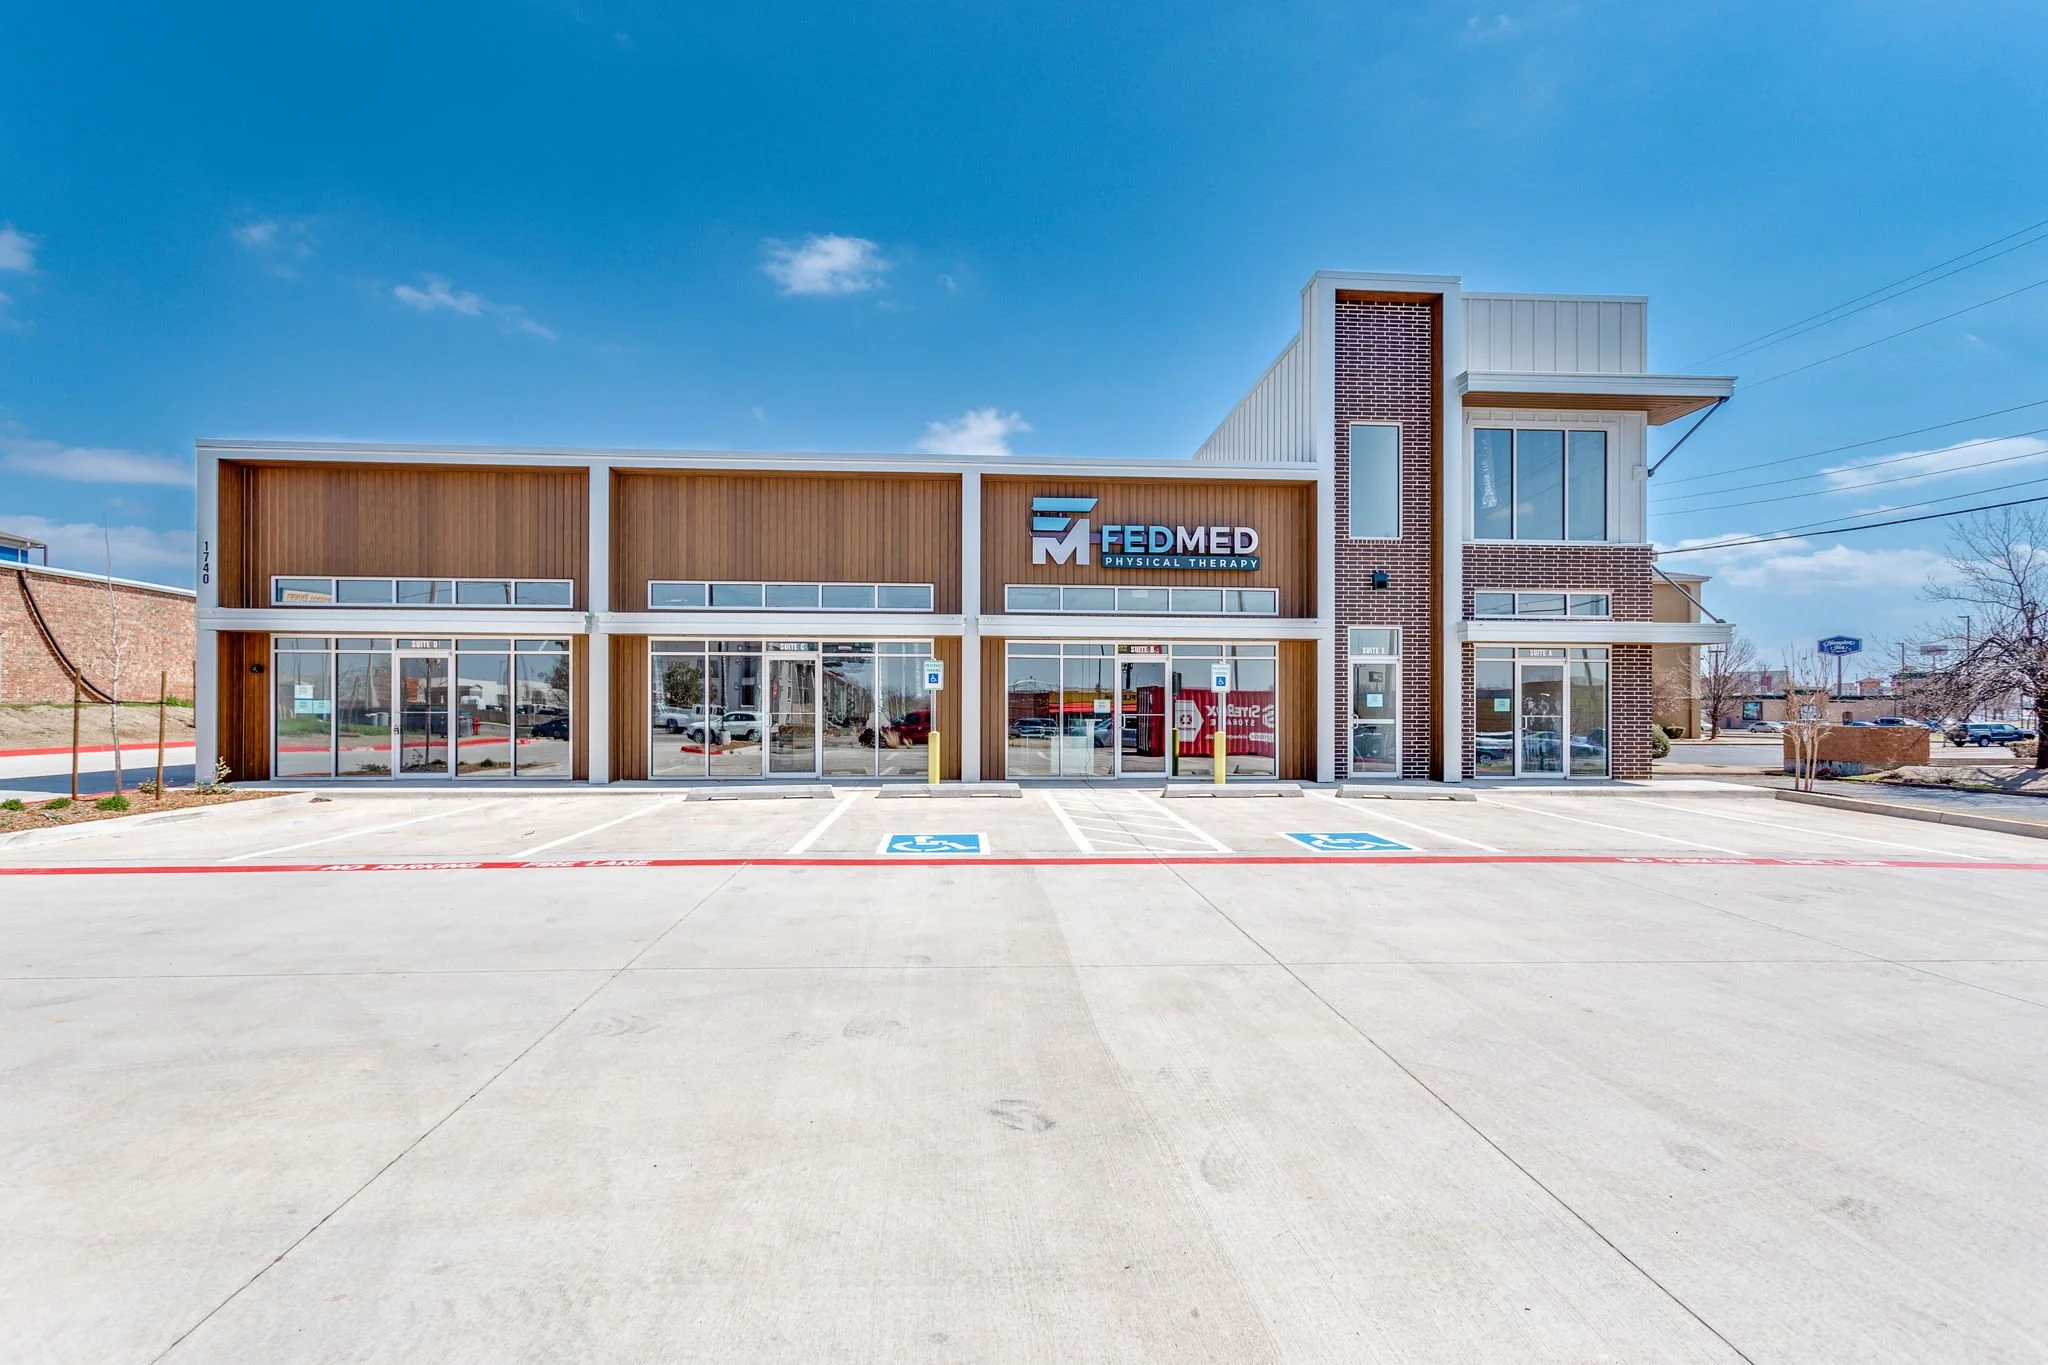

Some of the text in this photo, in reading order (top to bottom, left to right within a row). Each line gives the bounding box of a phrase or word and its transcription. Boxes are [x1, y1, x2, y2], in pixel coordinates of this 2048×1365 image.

[1102, 525, 1259, 554] FEDMED
[1105, 557, 1258, 568] PHYSICAL THERAPY
[411, 640, 431, 648] SUITE
[780, 642, 798, 650] SUITE
[1130, 645, 1148, 653] SUITE
